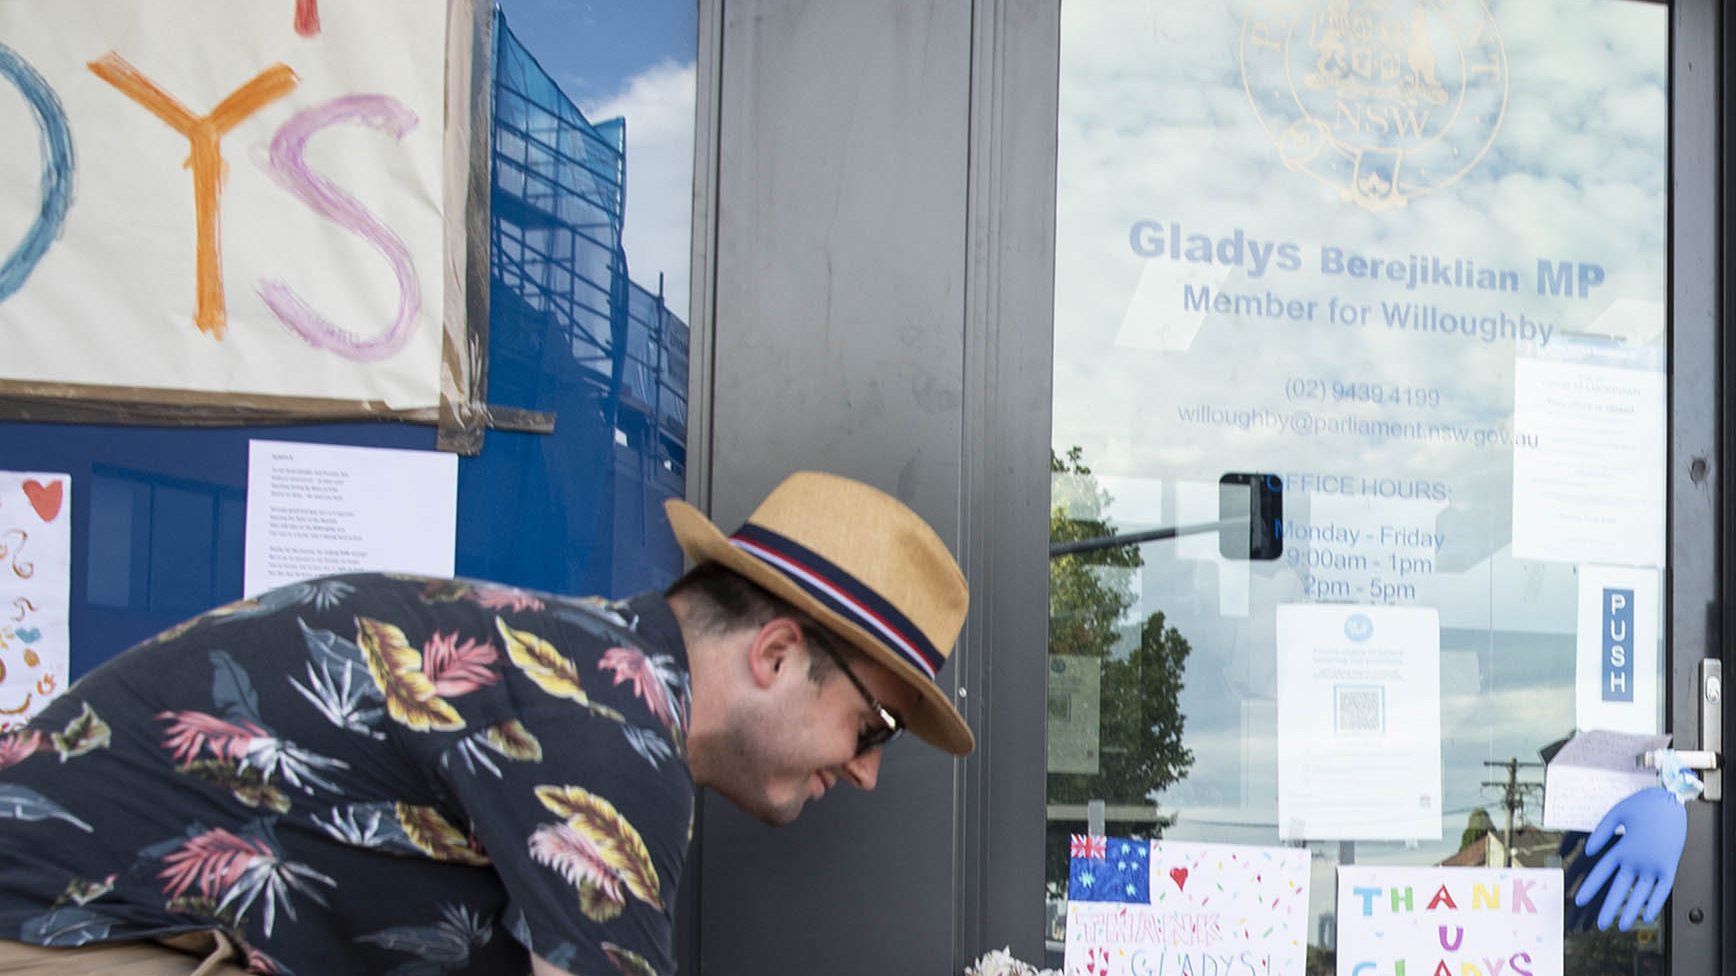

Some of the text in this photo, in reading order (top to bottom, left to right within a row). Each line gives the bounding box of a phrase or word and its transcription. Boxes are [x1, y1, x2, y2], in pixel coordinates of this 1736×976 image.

[1129, 219, 1605, 299] Gladys Berejiklian MP
[1184, 284, 1554, 347] Member for Willoughby
[1285, 378, 1326, 401] (02)
[1387, 387, 1440, 408] 4199
[1178, 404, 1539, 448] willoughby@parliament.nsw.gov.au
[1266, 473, 1354, 495] OFFICE
[1274, 519, 1360, 546] Monday
[1381, 526, 1445, 551] Friday
[1287, 551, 1367, 571] 9:00am
[1389, 552, 1432, 575] 1pm
[1304, 576, 1350, 598] 2pm
[1370, 578, 1416, 600] 5pm
[1610, 594, 1626, 693] PUSH
[1353, 878, 1538, 916] THANK
[1075, 910, 1225, 948] THANK
[1438, 925, 1464, 952] U
